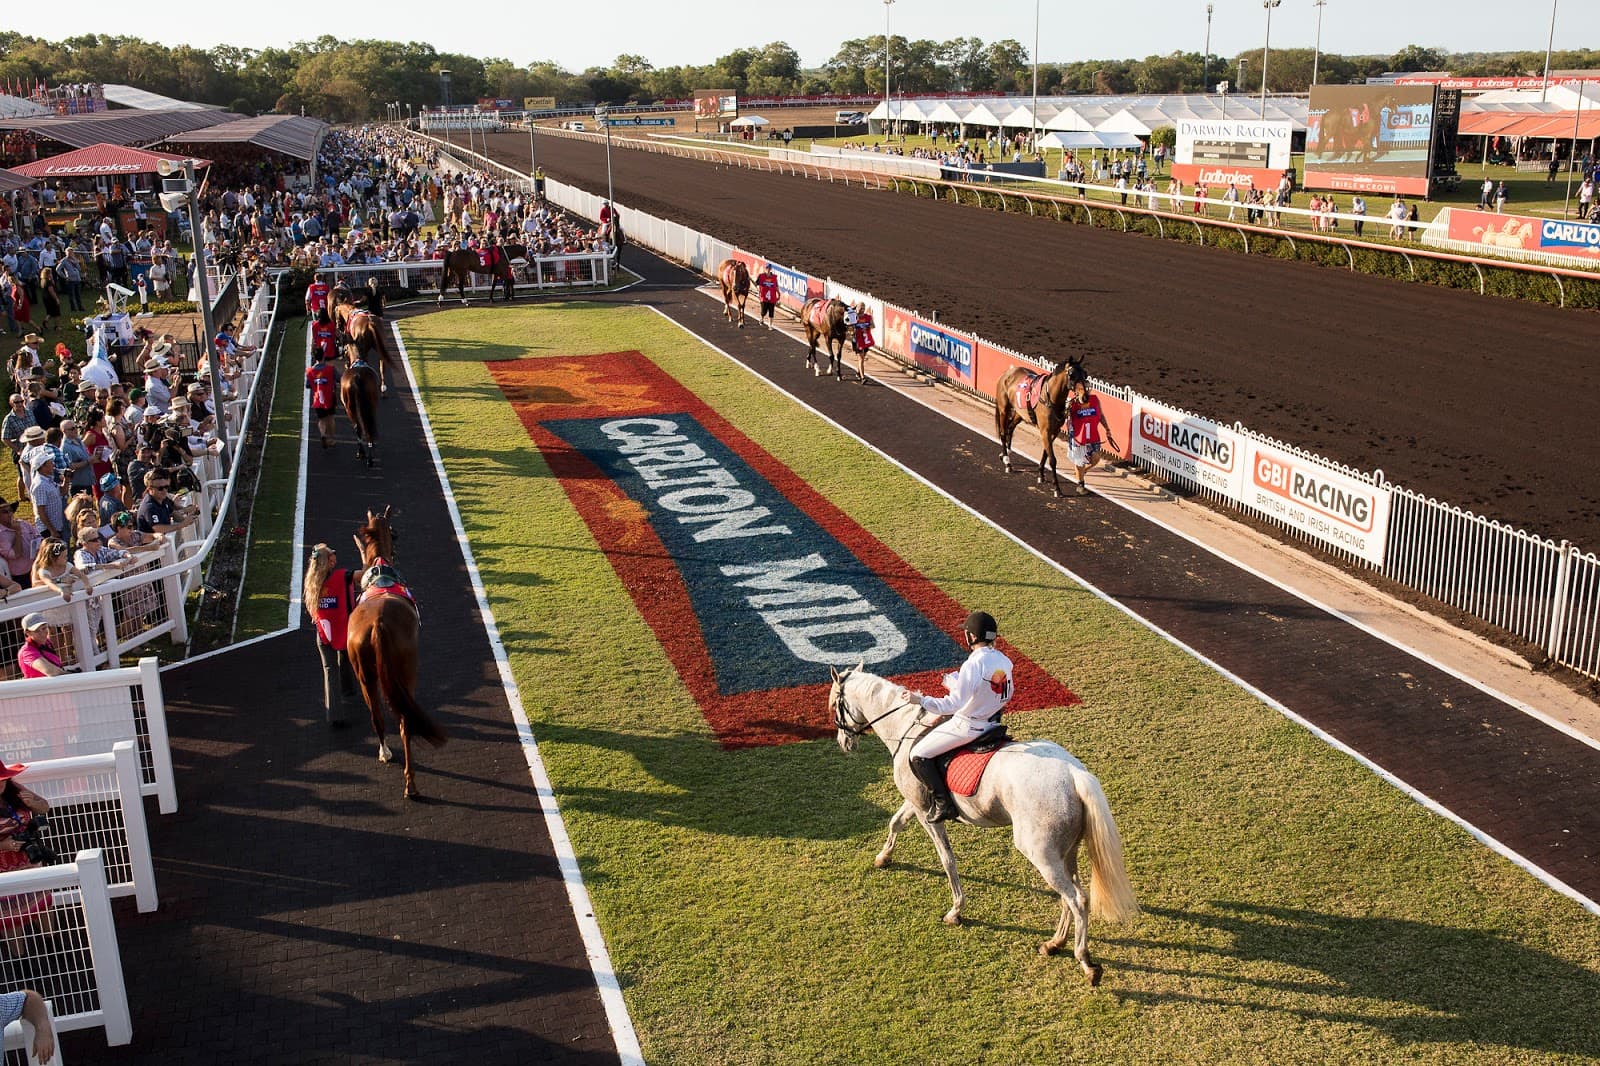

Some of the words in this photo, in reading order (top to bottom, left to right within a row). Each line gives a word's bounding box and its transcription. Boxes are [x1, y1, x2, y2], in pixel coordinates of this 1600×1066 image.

[1476, 80, 1514, 88] Ladbrokes
[1181, 123, 1232, 136] DARWIN
[1236, 124, 1287, 138] RACING
[44, 162, 142, 175] Ladbrokes
[1199, 168, 1254, 186] Ladbrokes
[1366, 183, 1396, 192] CROWN
[479, 256, 486, 267] 5
[765, 289, 772, 301] 4
[862, 332, 871, 345] 2
[911, 325, 949, 358] CARLTON
[950, 341, 970, 366] MID
[1084, 422, 1091, 439] 1
[1142, 413, 1168, 441] GBI
[1170, 424, 1230, 465] RACING
[1143, 444, 1166, 461] BRITISH
[1167, 455, 1182, 469] AND
[1183, 466, 1200, 480] IRISH
[1202, 470, 1228, 489] RACING
[1257, 458, 1288, 491] GBI
[1293, 472, 1369, 523] RACING
[1256, 493, 1286, 514] BRITISH
[1288, 508, 1305, 524] AND
[1308, 516, 1330, 535] IRISH
[1333, 527, 1366, 551] RACING
[600, 418, 793, 543] CARLTON
[719, 552, 909, 666] MID
